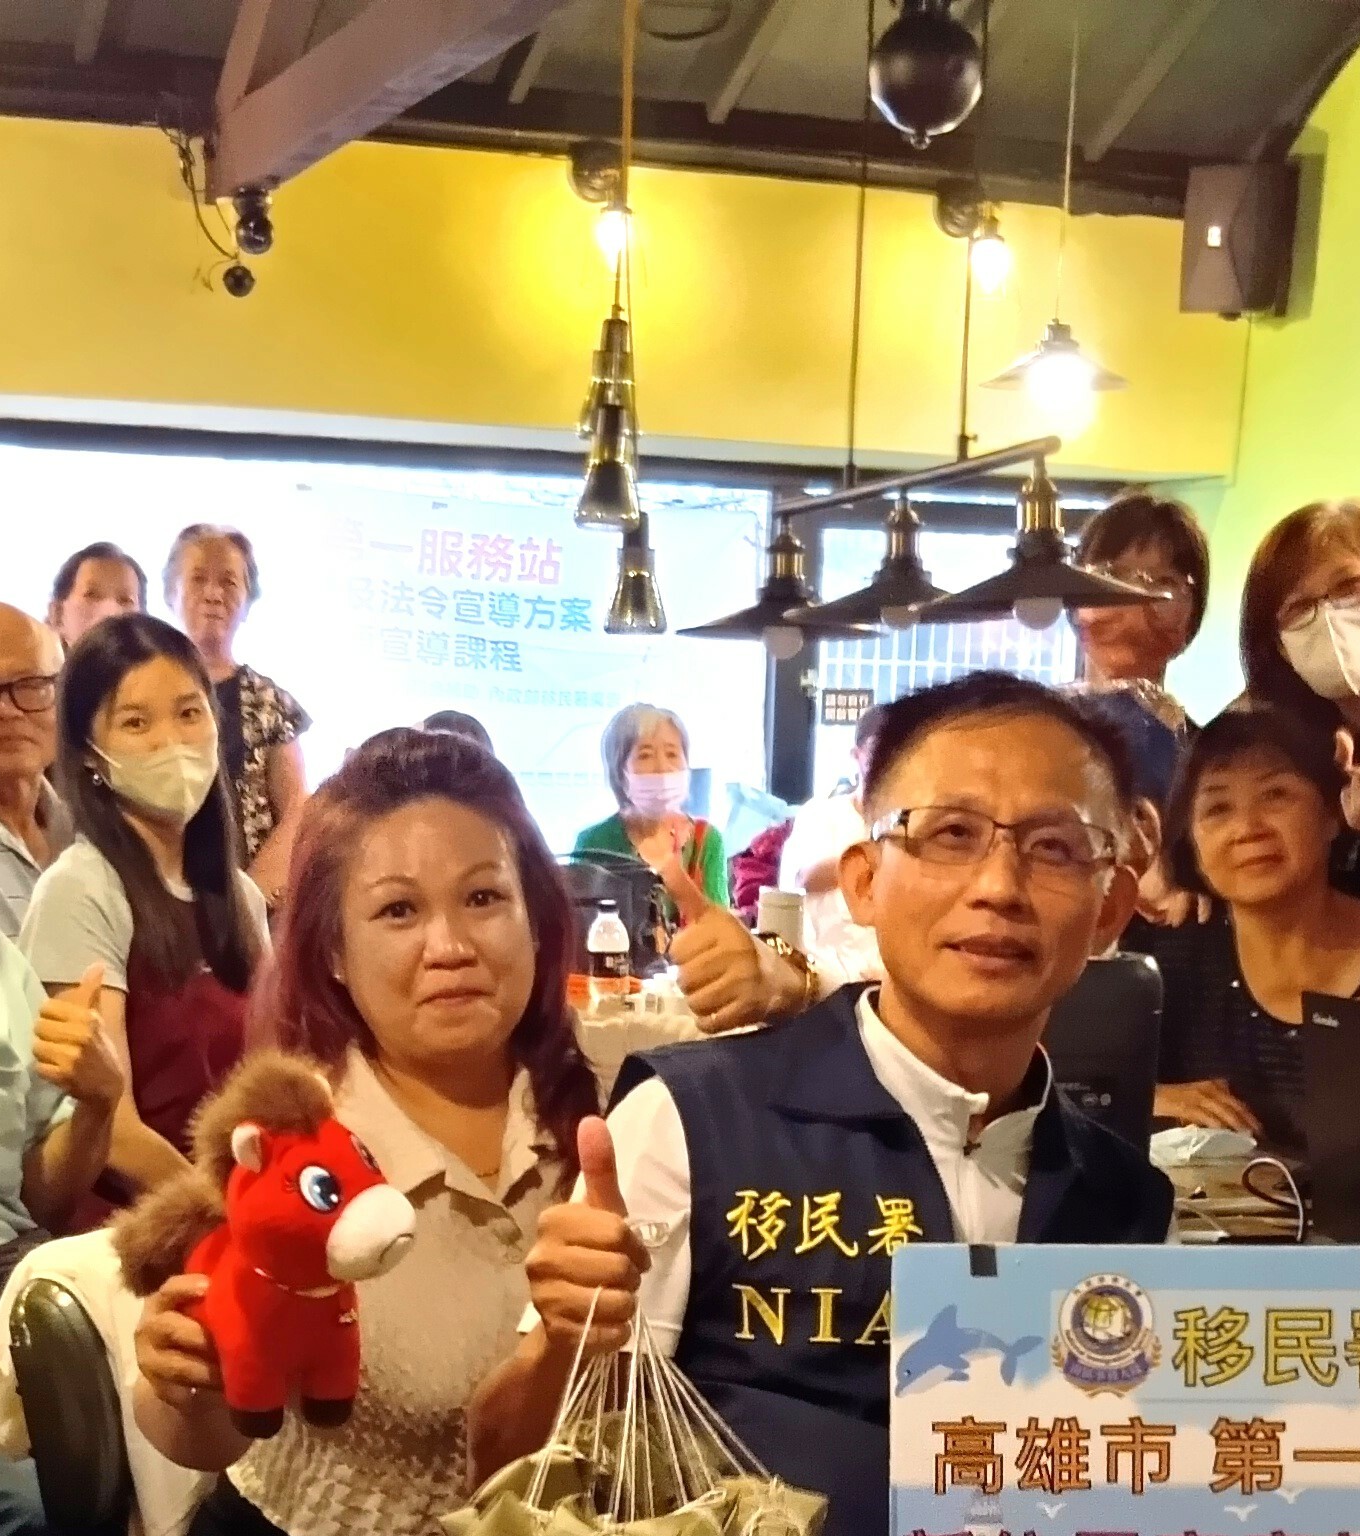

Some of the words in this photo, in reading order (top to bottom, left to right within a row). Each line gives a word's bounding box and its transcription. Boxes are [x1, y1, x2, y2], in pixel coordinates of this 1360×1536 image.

[362, 624, 523, 673] 宣導課程
[726, 1190, 924, 1261] 移民署
[931, 1415, 1178, 1495] 高雄市
